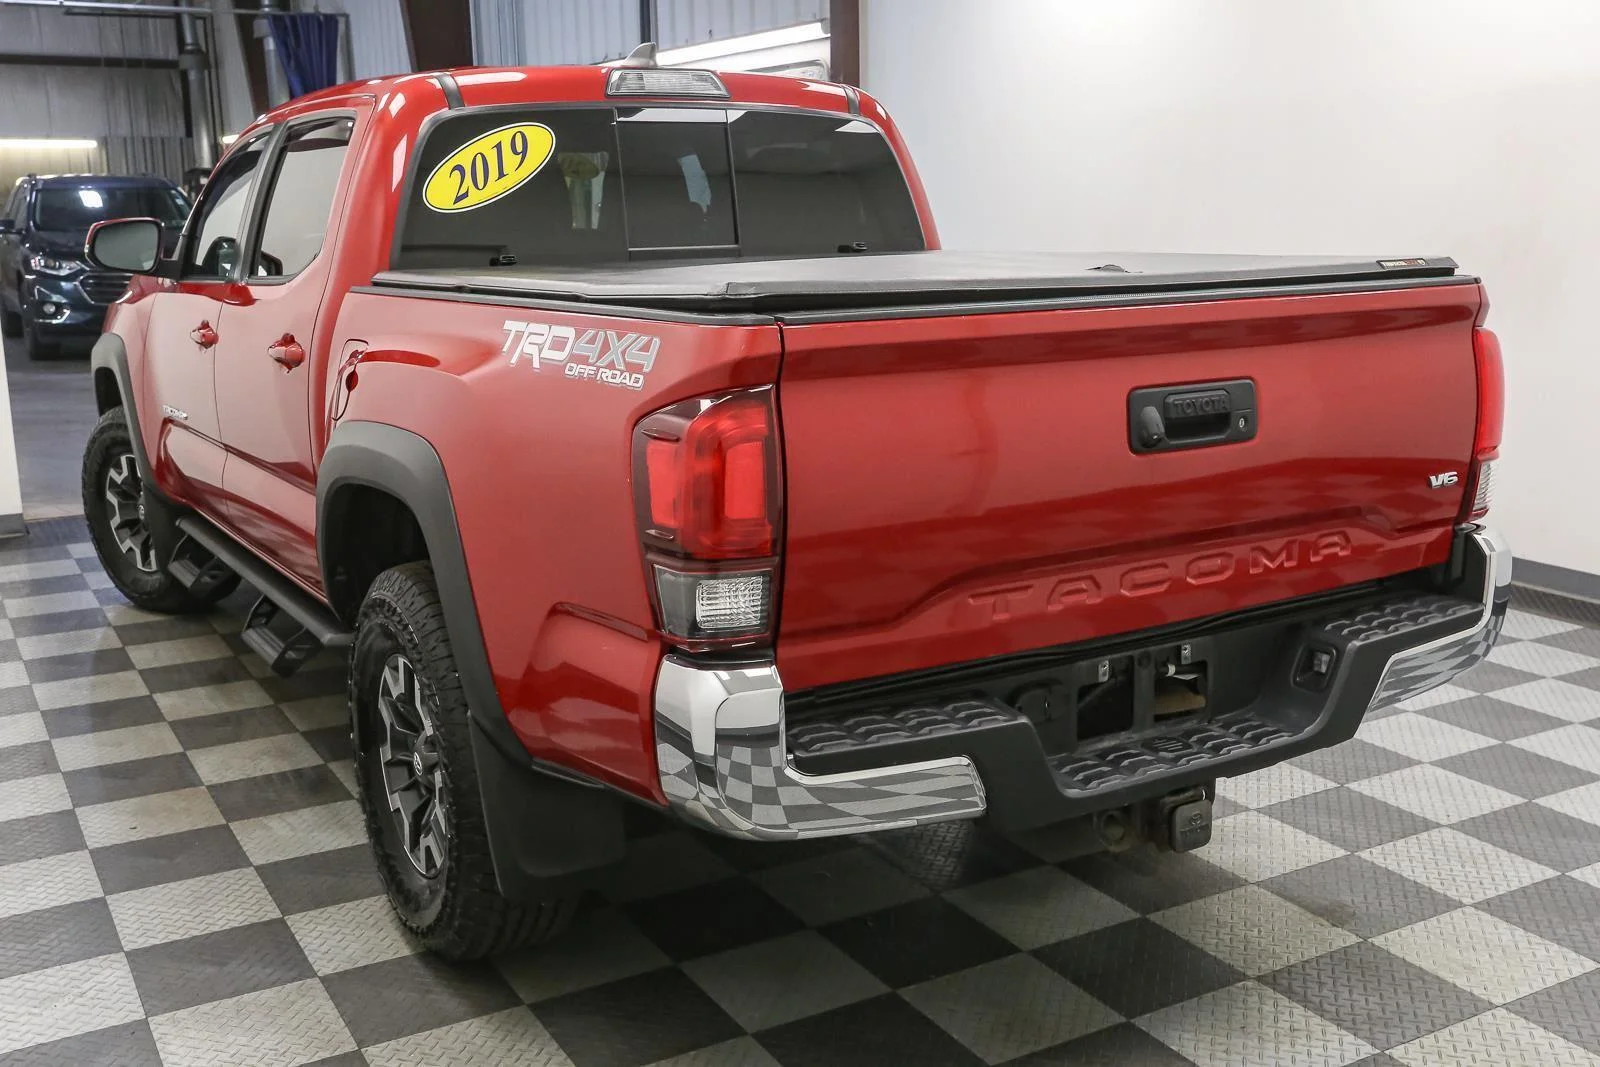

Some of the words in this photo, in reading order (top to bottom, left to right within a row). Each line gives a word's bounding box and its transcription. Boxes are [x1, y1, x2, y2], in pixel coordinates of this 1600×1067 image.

[449, 130, 529, 205] 2019
[564, 363, 597, 378] OFF
[596, 369, 645, 388] ROAD
[1173, 396, 1229, 414] TOYOTA
[1429, 471, 1459, 489] V6
[967, 530, 1352, 620] TACOMA
